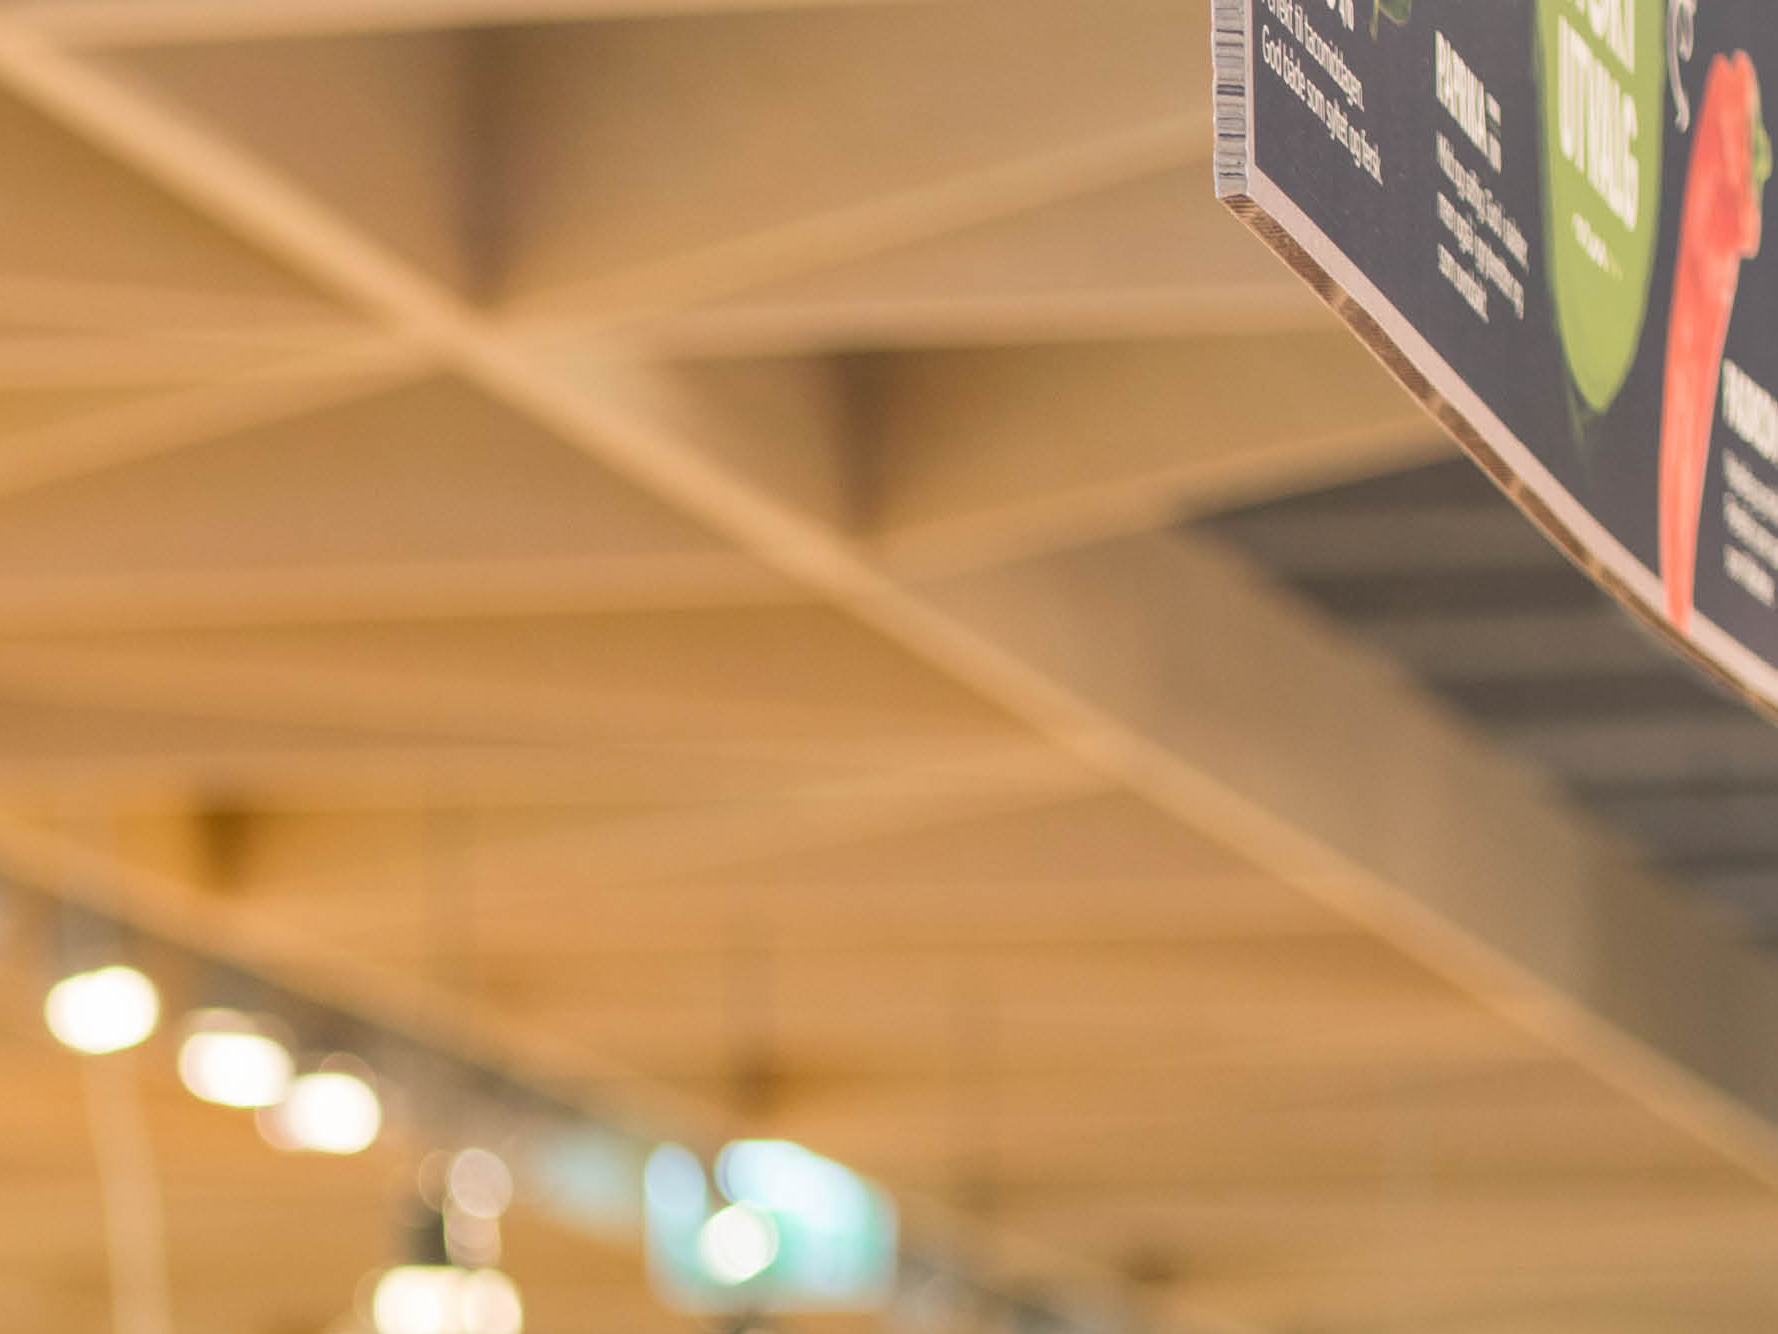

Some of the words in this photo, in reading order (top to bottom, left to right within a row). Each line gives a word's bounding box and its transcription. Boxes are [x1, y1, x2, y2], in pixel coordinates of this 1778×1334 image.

[1262, 23, 1283, 78] God
[1282, 43, 1306, 102] både
[1306, 78, 1326, 123] som
[1348, 124, 1362, 169] og
[1435, 30, 1488, 157] PAPRIKA
[1557, 15, 1638, 233] UTVALG
